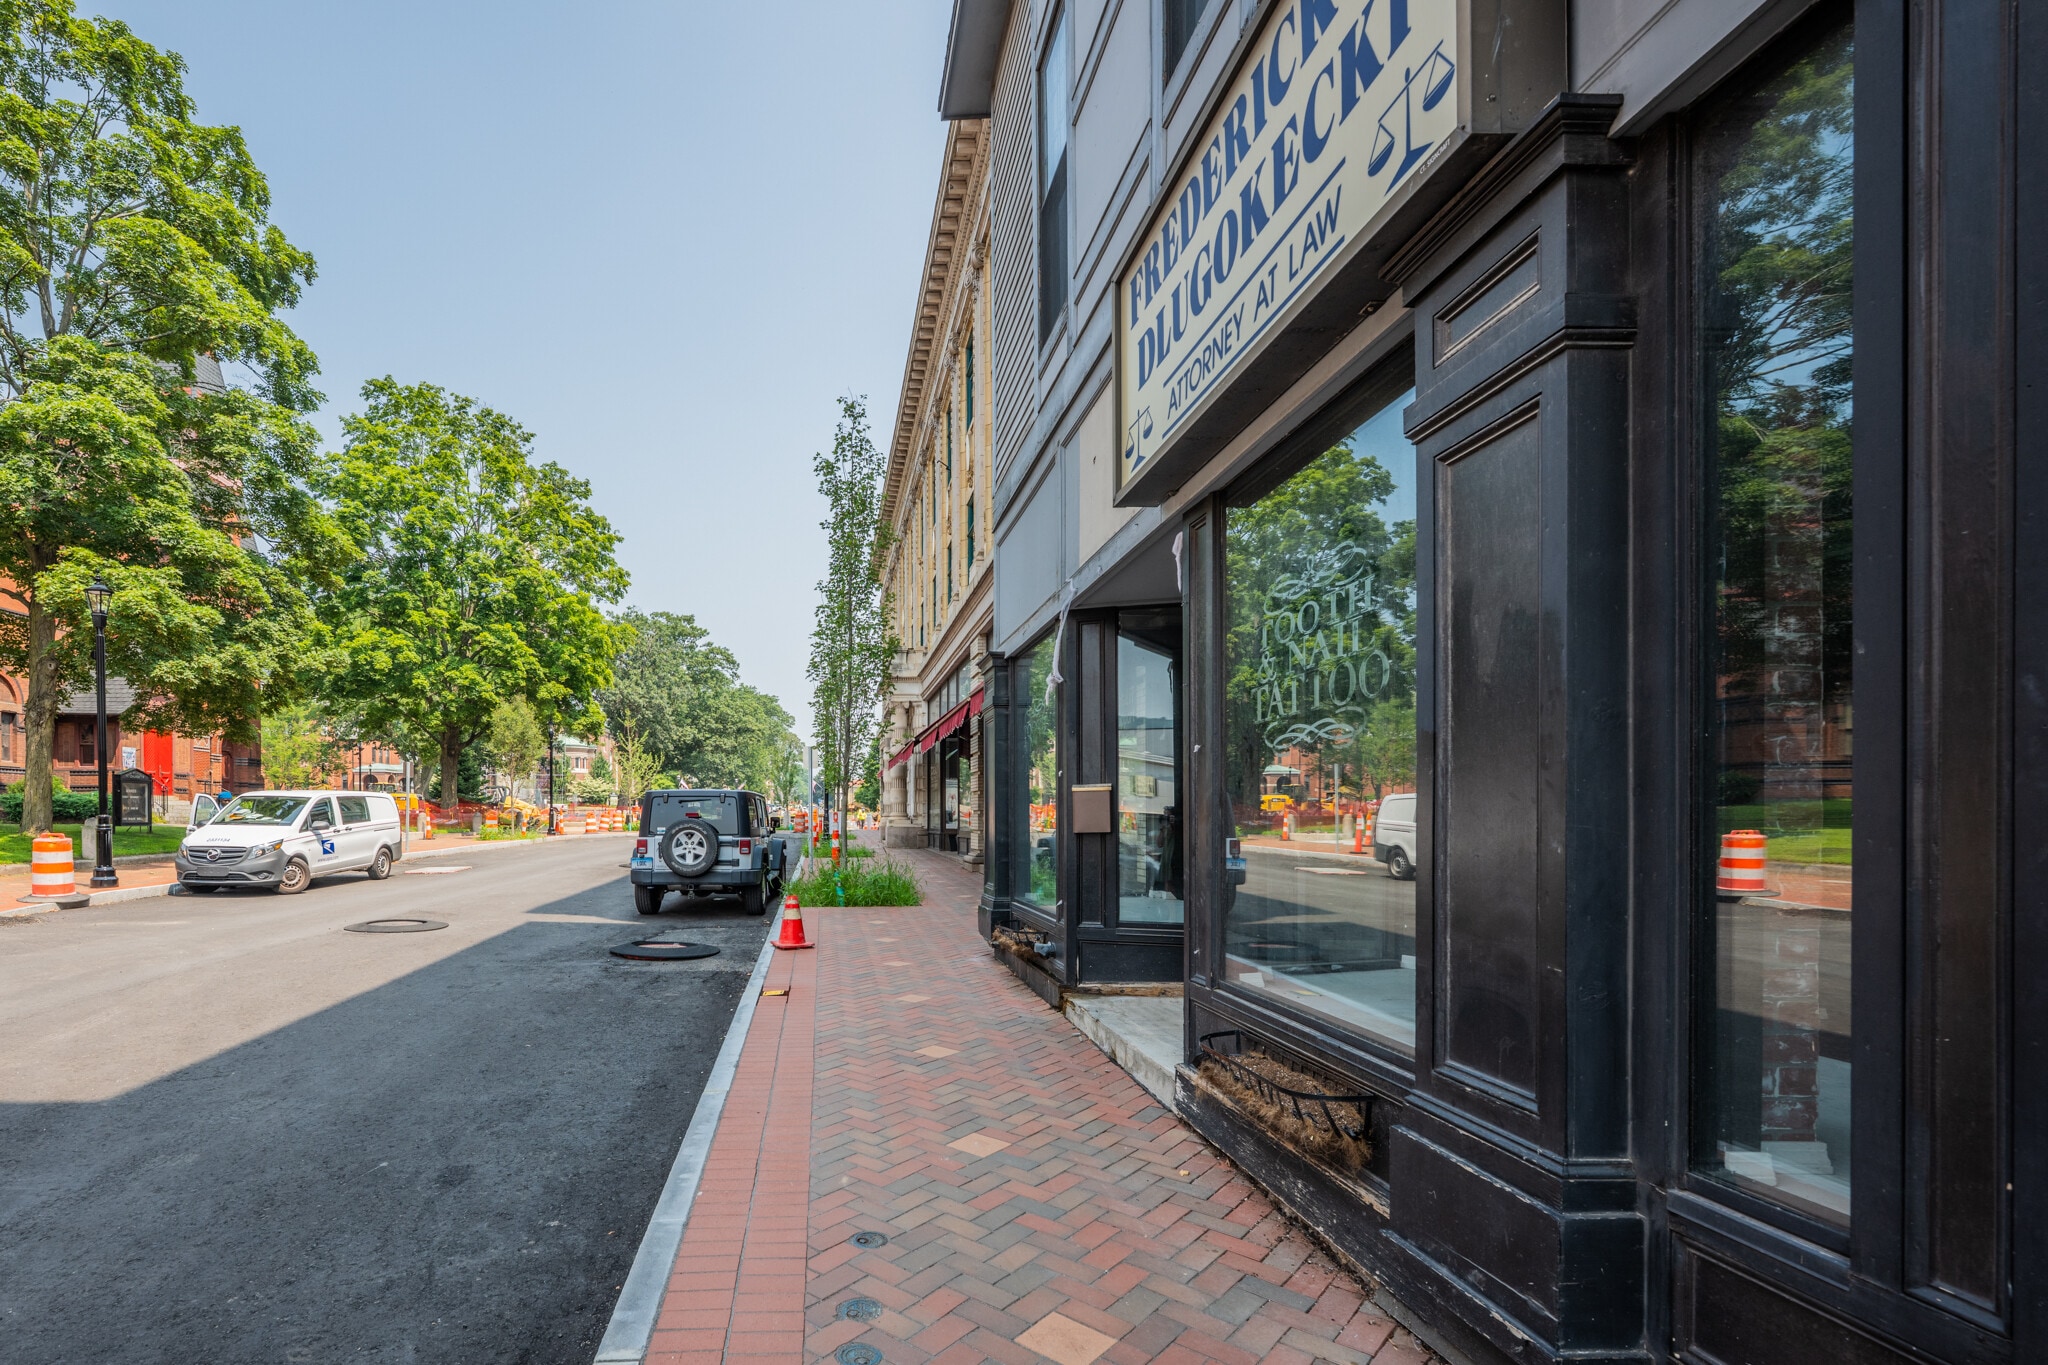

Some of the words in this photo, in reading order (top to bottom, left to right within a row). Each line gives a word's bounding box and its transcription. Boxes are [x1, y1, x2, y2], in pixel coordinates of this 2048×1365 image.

[1130, 0, 1339, 330] FREDERICK
[1167, 302, 1245, 420] ATTORNEY
[1253, 262, 1278, 323] AT
[1289, 183, 1342, 282] LAW
[1258, 651, 1277, 684] &
[1286, 615, 1376, 676] NAIL
[1260, 574, 1376, 652] TOOTH
[1251, 650, 1390, 724] TATTOO
